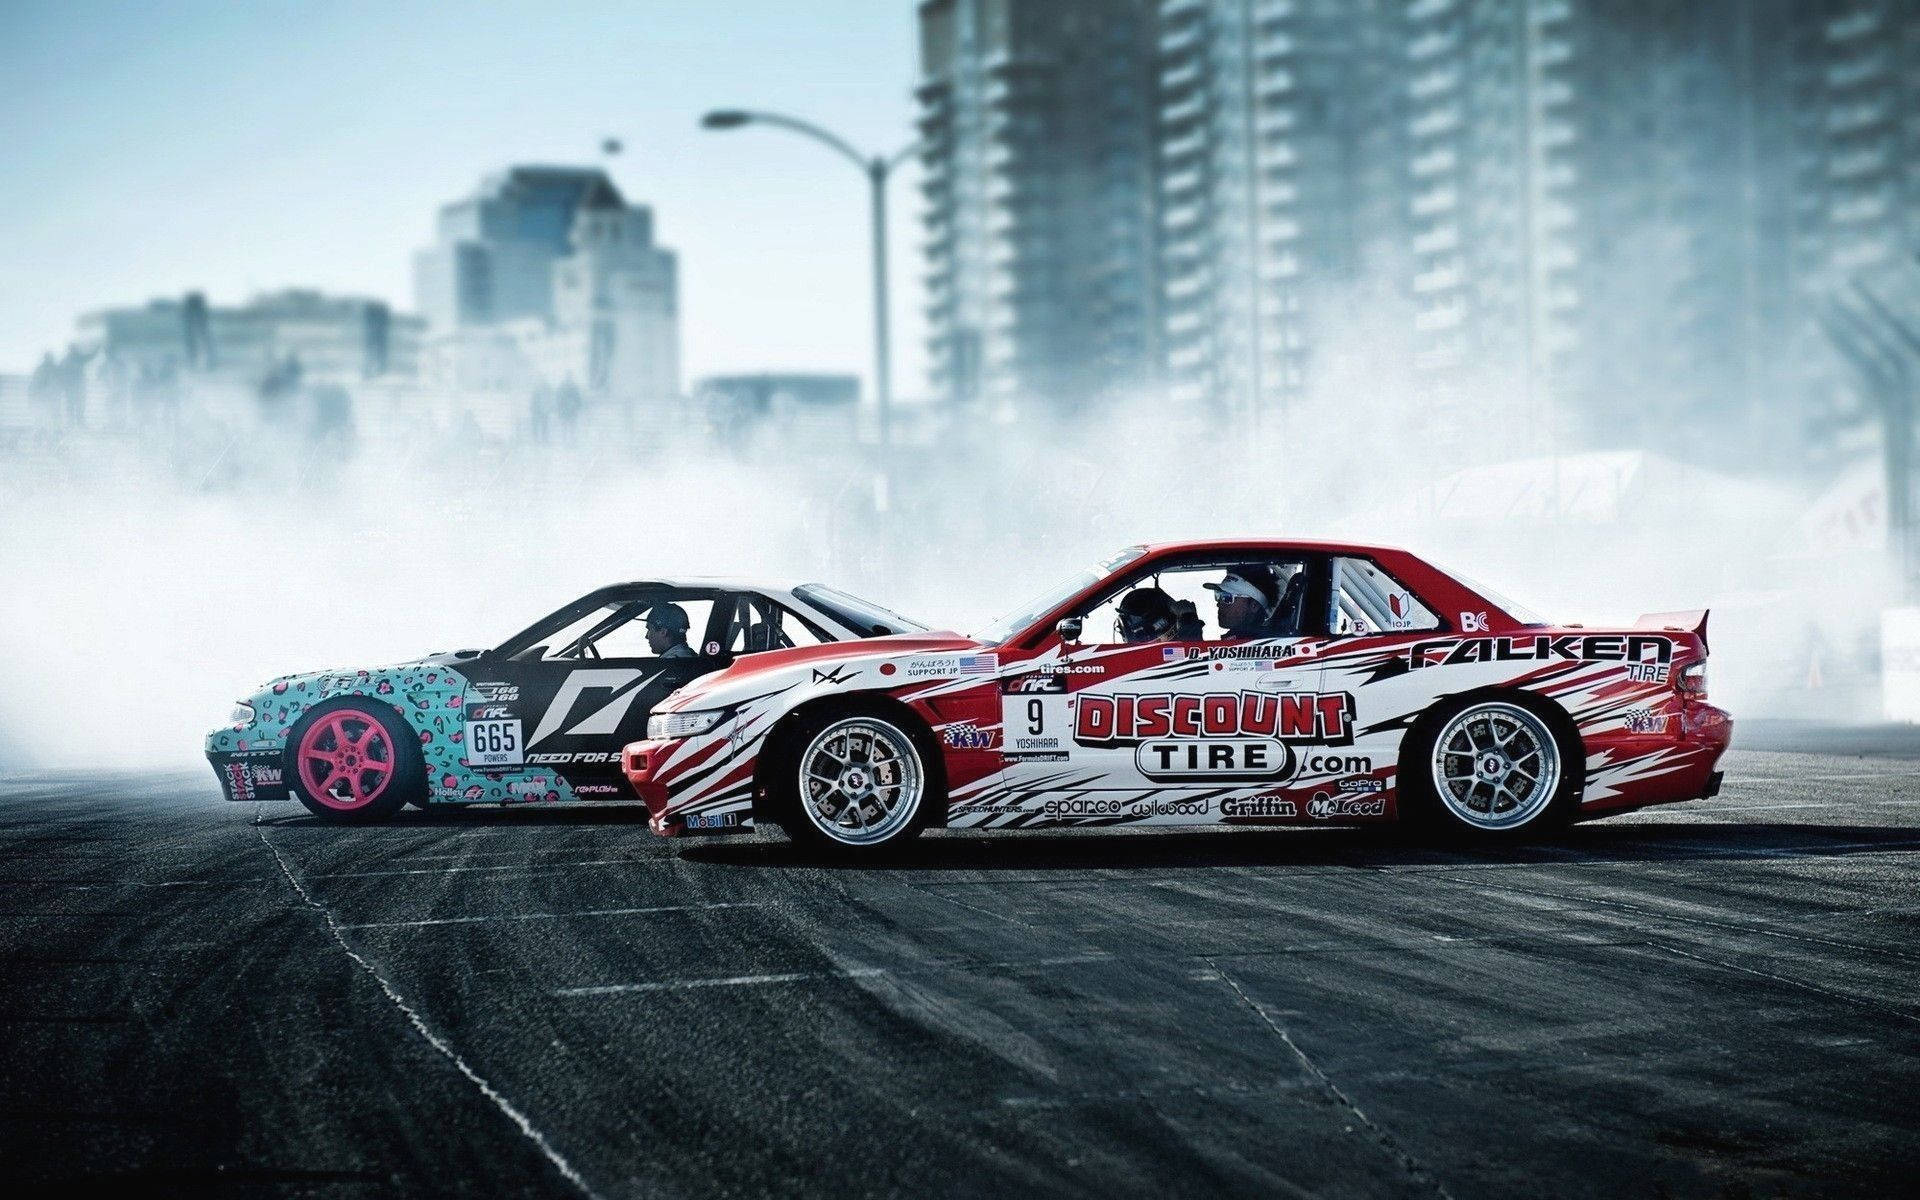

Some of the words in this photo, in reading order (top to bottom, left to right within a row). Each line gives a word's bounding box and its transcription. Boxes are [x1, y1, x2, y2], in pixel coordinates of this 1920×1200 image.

[1188, 647, 1202, 660] D.
[1207, 644, 1293, 660] YOSHIHARA
[1408, 634, 1673, 671] FALKEN
[907, 669, 946, 677] SUPPORT
[949, 667, 958, 675] JP
[1039, 664, 1105, 675] tires.com
[1626, 664, 1669, 683] TIRE
[1027, 698, 1044, 736] 9
[1075, 691, 1350, 741] DISCOUNT
[1631, 717, 1668, 733] KW
[474, 723, 515, 752] 665
[952, 730, 995, 748] KW
[1016, 738, 1059, 749] YOSHIHARA
[484, 753, 508, 762] POWERS
[525, 753, 571, 763] NEED
[572, 752, 608, 762] FOR
[1152, 744, 1268, 769] TIRE
[239, 761, 255, 799] STACK
[256, 769, 282, 781] KW
[1339, 779, 1382, 788] GoPro
[434, 787, 464, 799] Holley
[1044, 800, 1122, 819] sparco
[1131, 798, 1209, 816] wilwood
[1220, 797, 1297, 816] Griffin
[1307, 799, 1386, 818] McLeod
[686, 814, 724, 828] Mobil
